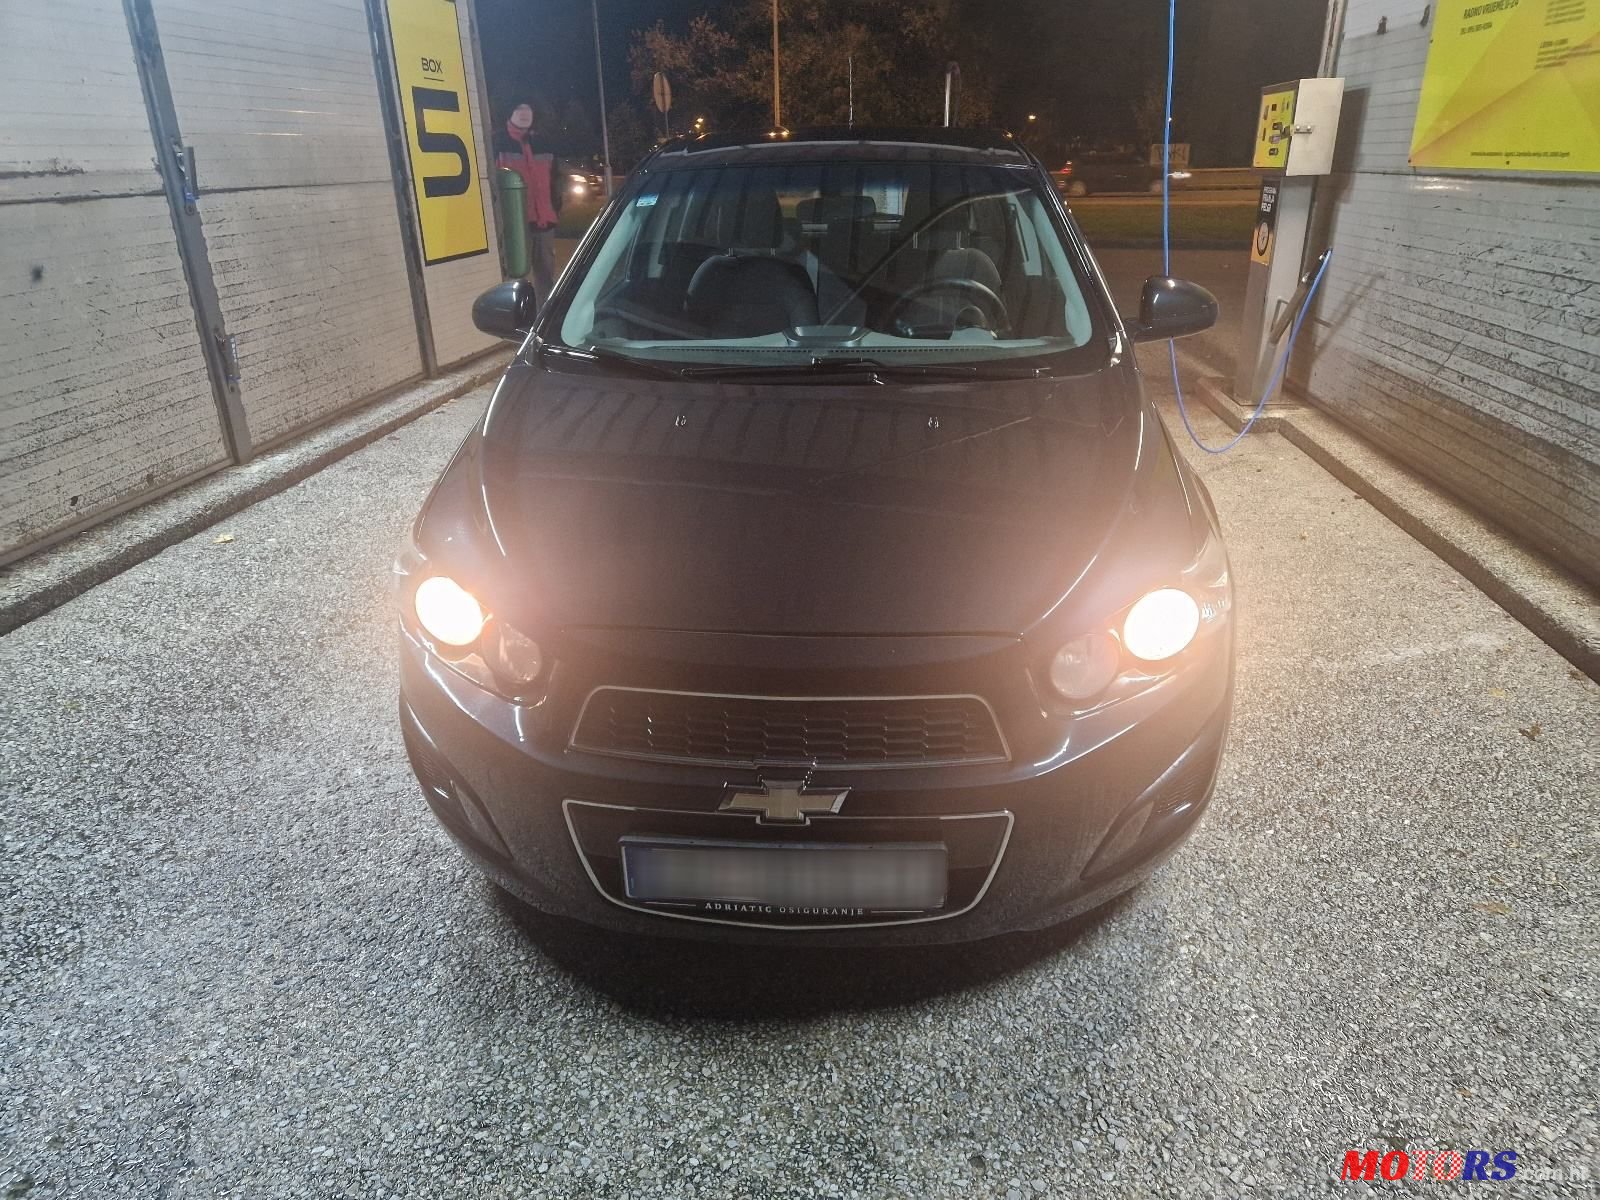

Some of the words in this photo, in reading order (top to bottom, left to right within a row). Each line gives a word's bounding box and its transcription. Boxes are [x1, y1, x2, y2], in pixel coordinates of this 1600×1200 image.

[421, 57, 444, 74] BOX
[412, 86, 471, 198] 5
[704, 902, 772, 914] ADRIATIC
[779, 905, 865, 917] OSIGURANJE
